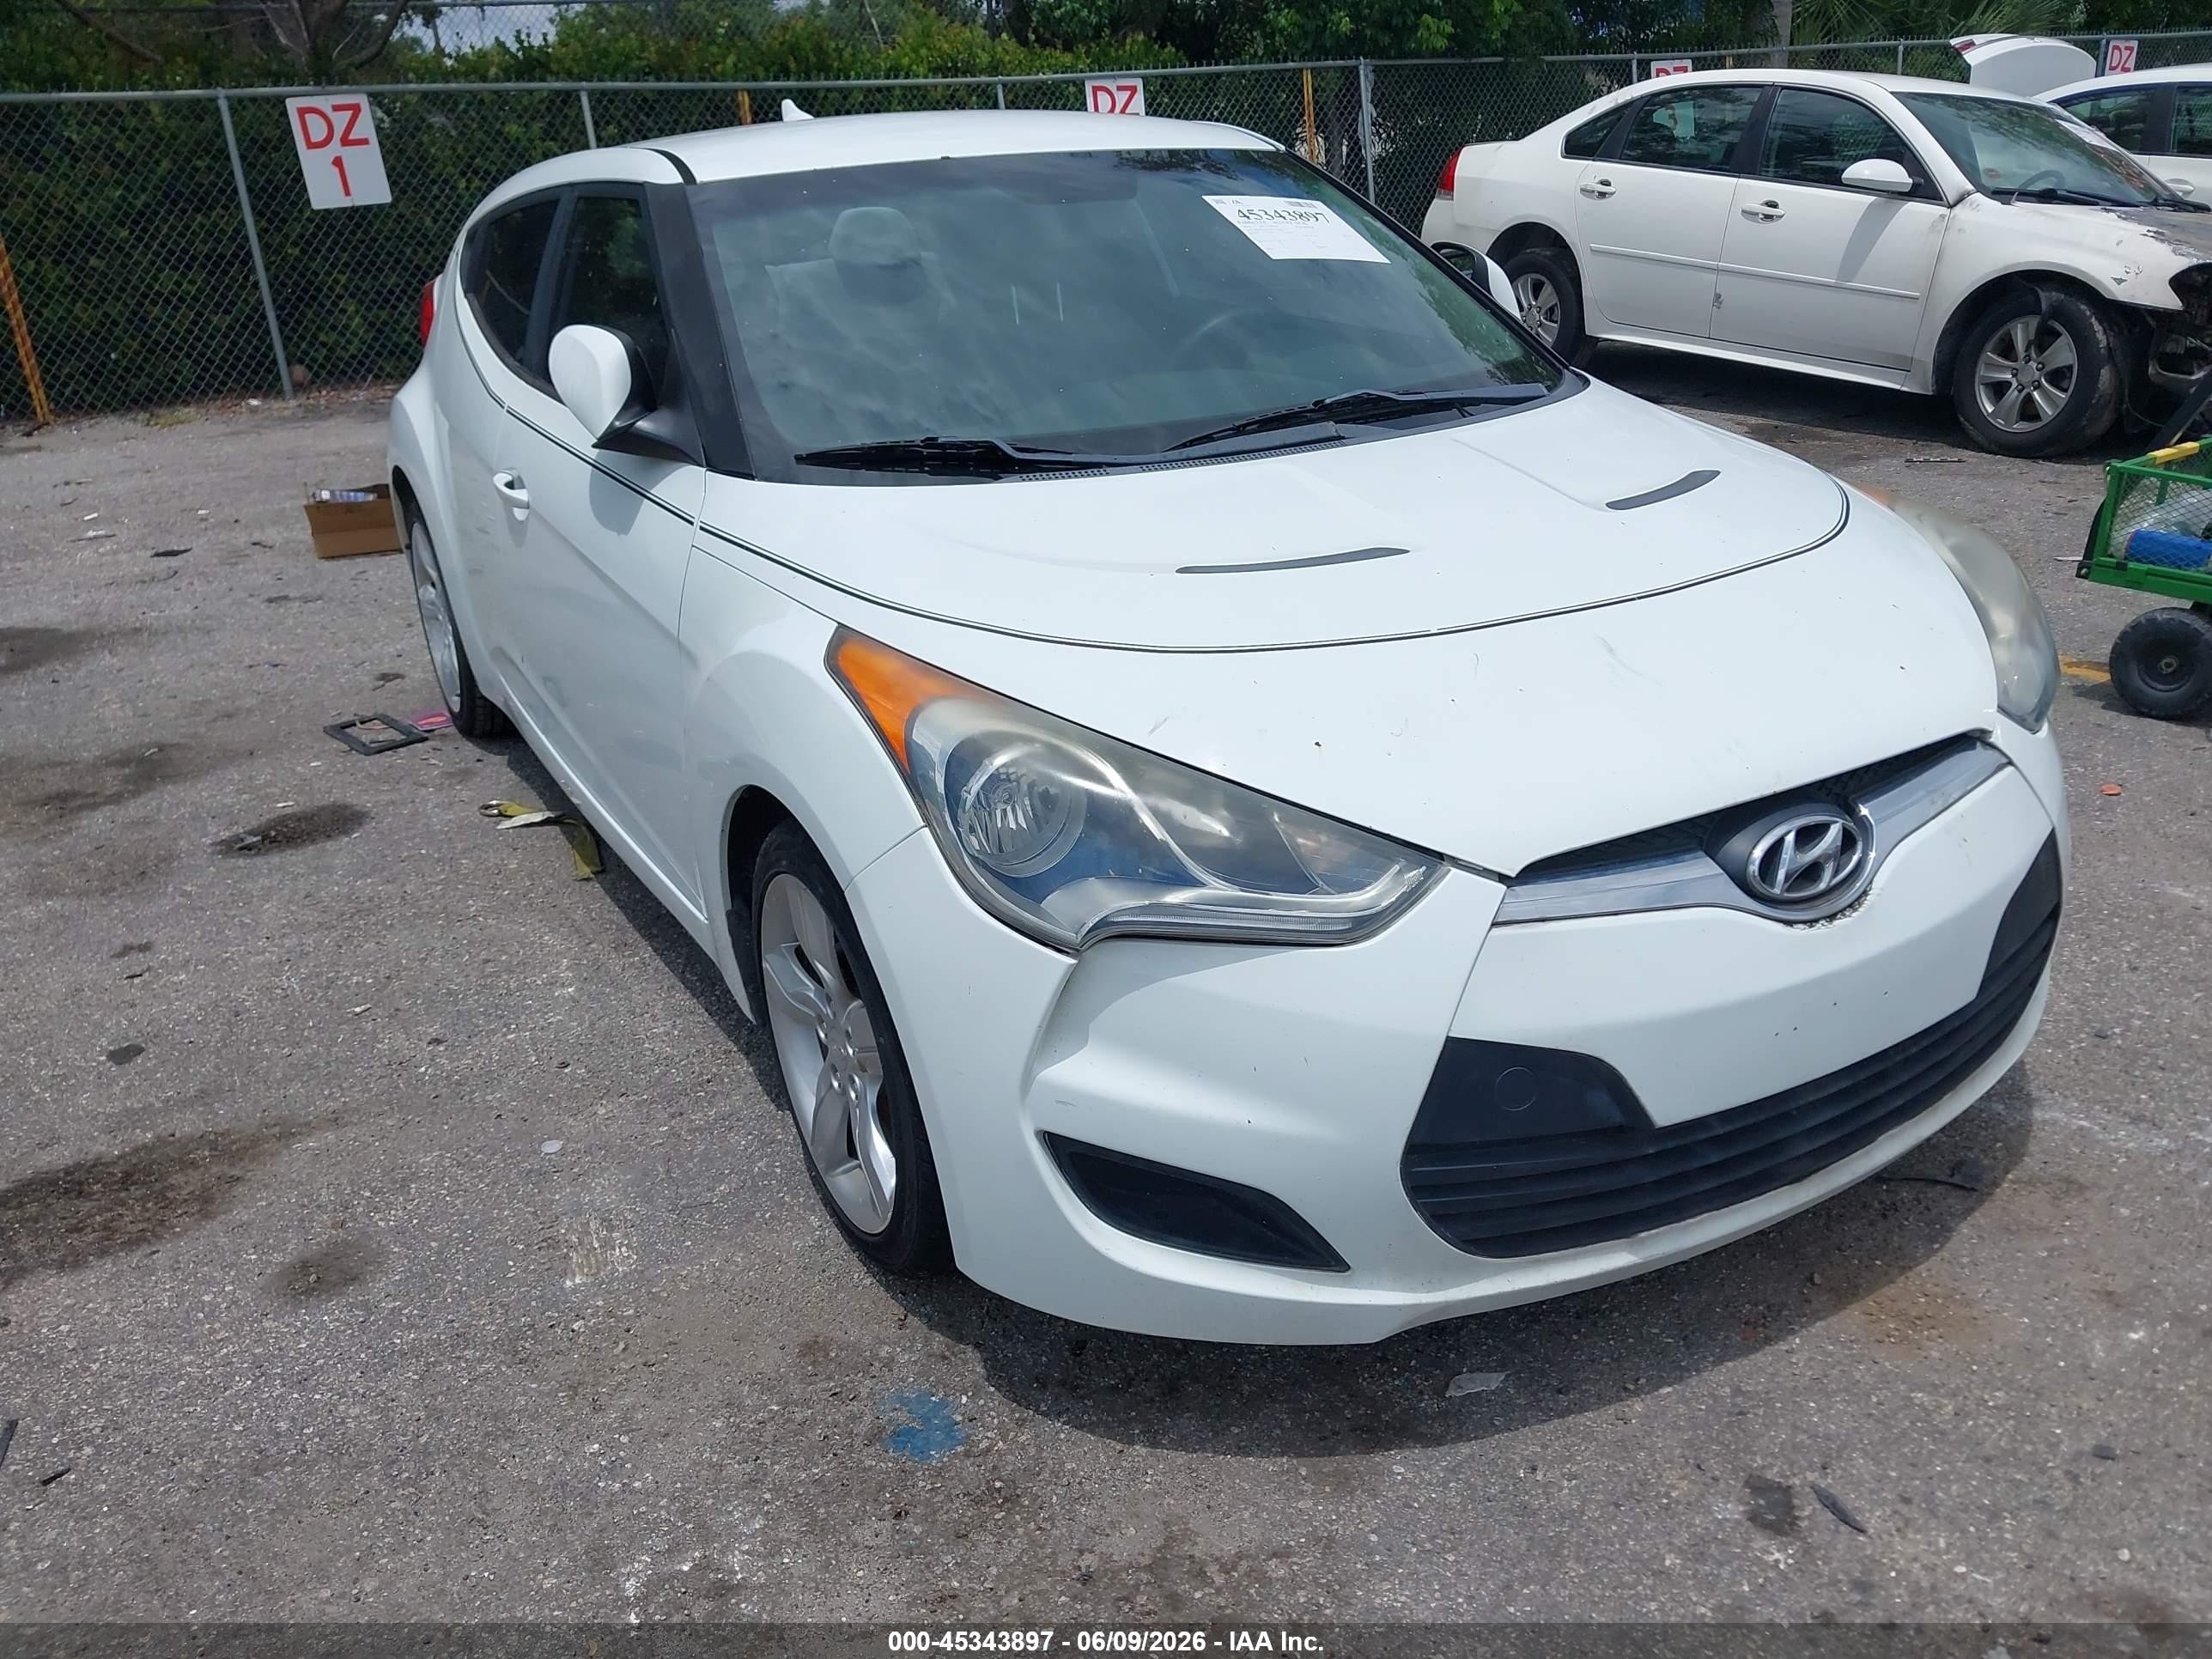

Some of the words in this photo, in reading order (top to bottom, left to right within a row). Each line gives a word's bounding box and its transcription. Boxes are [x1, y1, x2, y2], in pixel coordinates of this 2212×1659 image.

[2108, 45, 2135, 72] DZ
[1091, 85, 1139, 114] DZ
[296, 103, 370, 150] DZ
[331, 155, 351, 197] 1
[1237, 208, 1330, 224] 45343897
